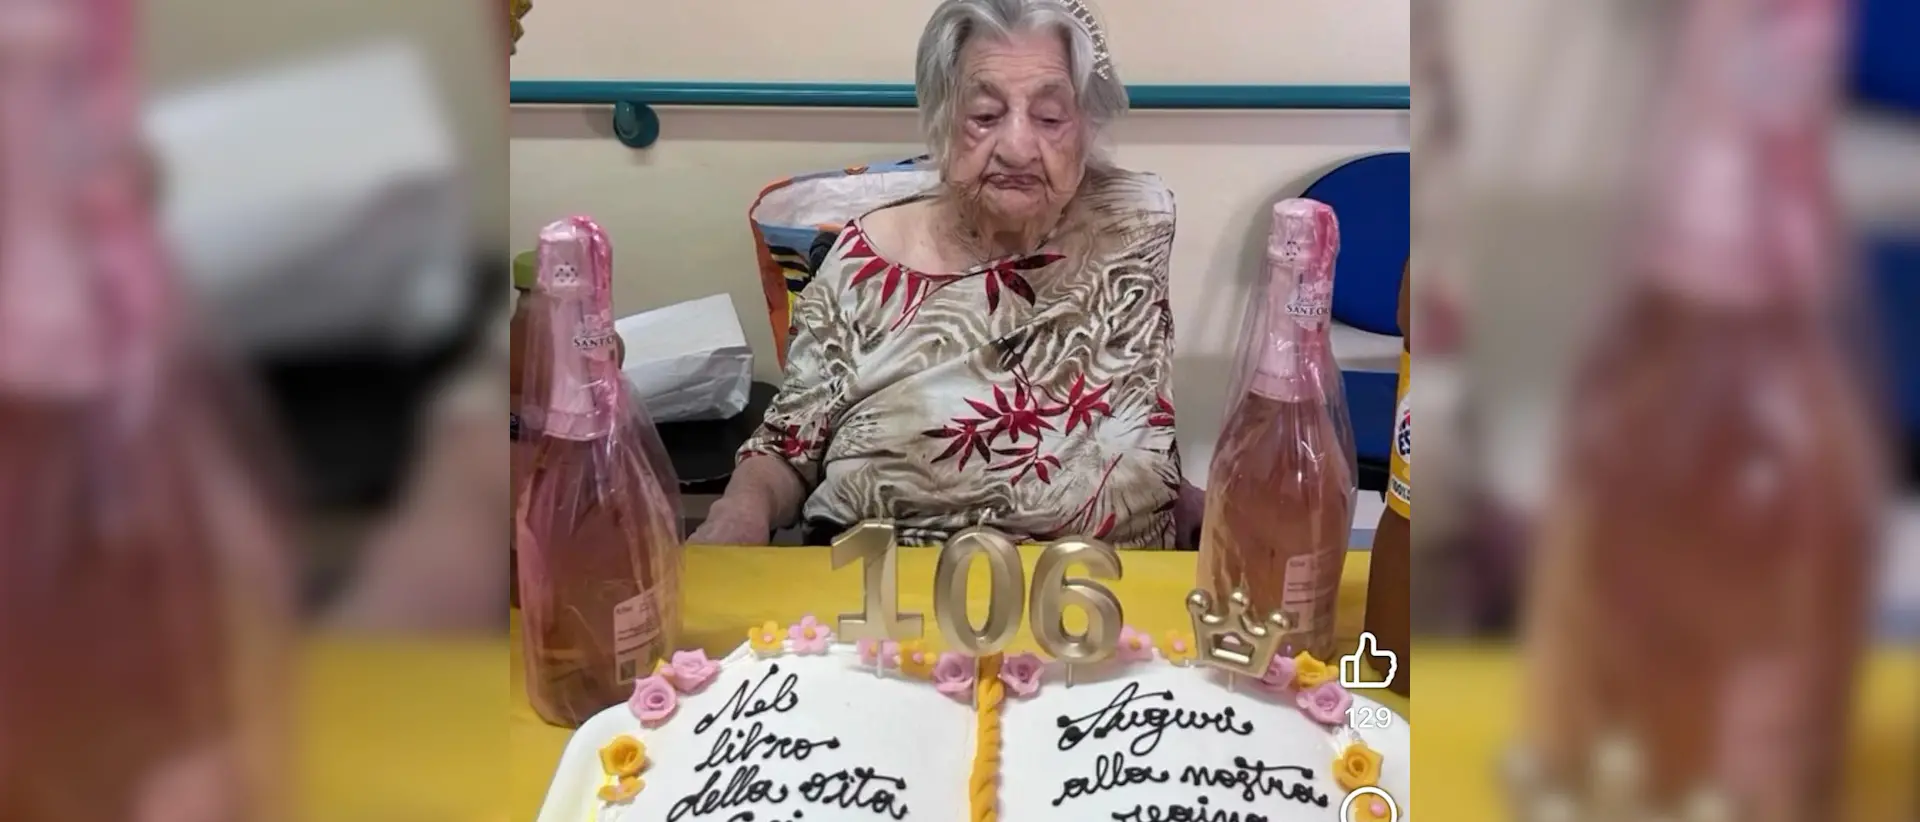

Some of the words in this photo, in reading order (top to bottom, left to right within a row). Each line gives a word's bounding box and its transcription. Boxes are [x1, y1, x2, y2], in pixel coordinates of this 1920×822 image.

[831, 523, 1124, 664] 106
[694, 663, 799, 734] Nel
[1057, 681, 1254, 756] Auguri
[694, 721, 841, 772] libro
[667, 764, 789, 822] della
[798, 766, 907, 820] vita
[1052, 752, 1170, 806] alla
[1180, 756, 1329, 808] nostra
